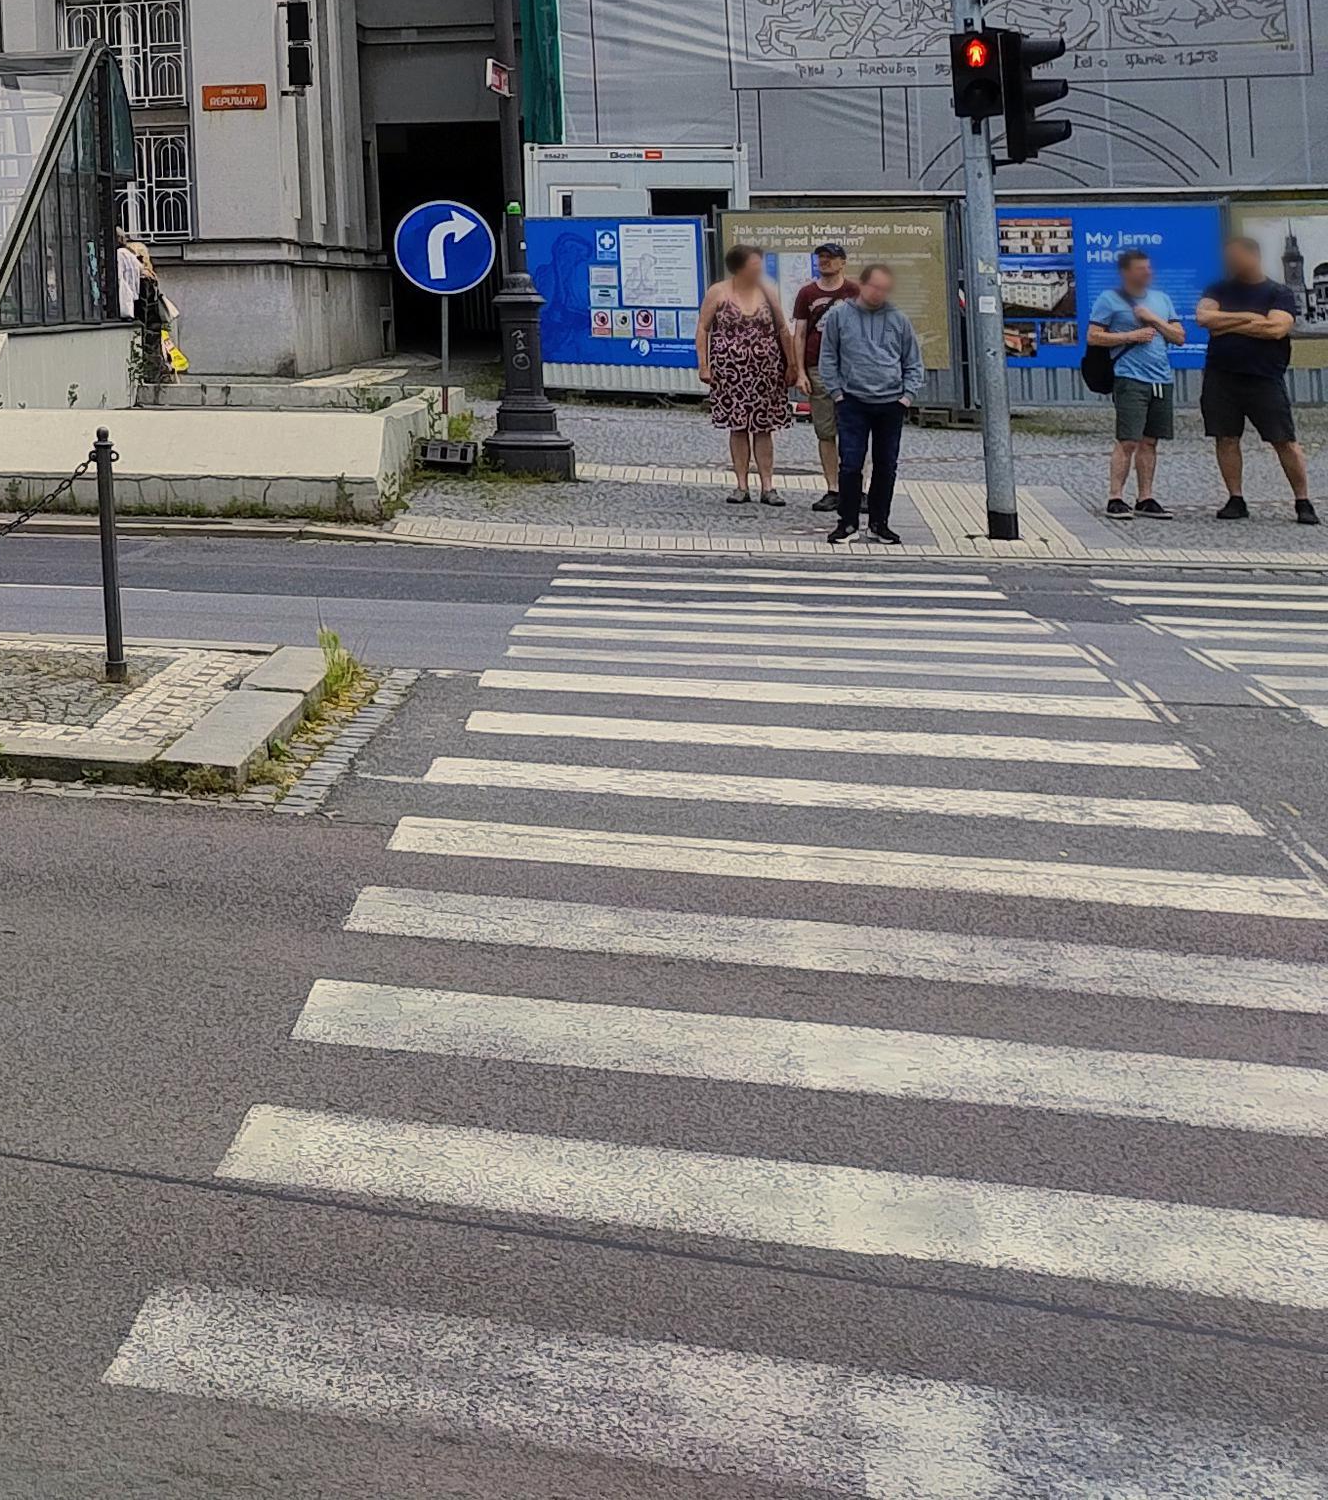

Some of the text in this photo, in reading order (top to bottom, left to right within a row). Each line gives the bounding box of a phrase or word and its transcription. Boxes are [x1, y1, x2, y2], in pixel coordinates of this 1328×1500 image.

[732, 225, 753, 235] Jak
[757, 225, 810, 235] zachovat
[784, 236, 809, 248] pod
[1085, 230, 1163, 248] My jsme
